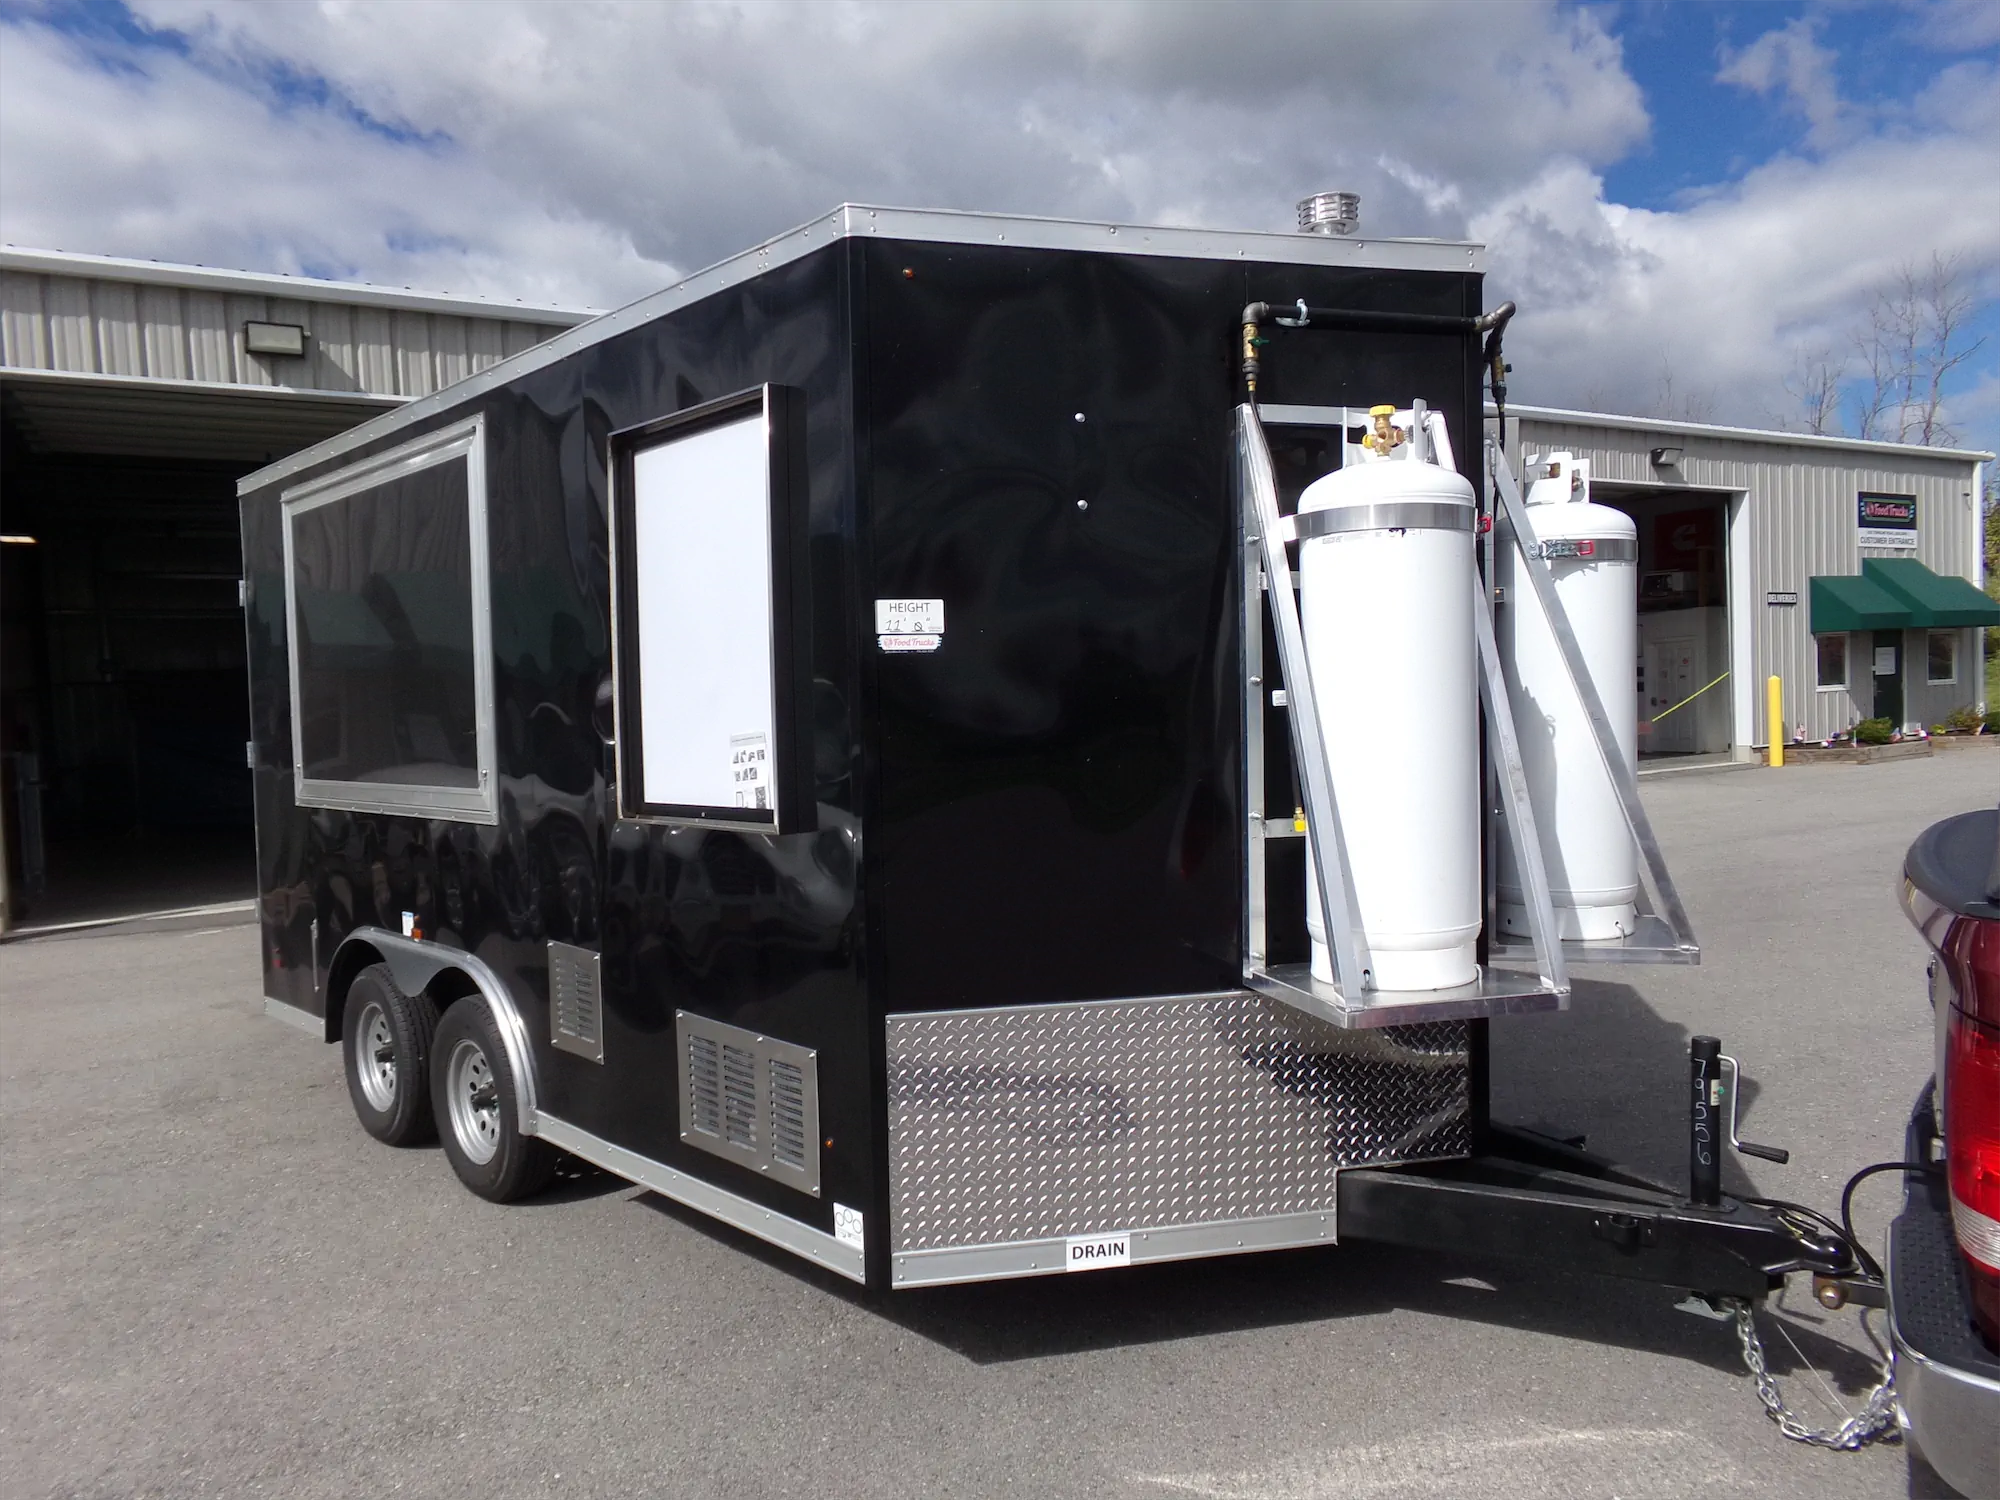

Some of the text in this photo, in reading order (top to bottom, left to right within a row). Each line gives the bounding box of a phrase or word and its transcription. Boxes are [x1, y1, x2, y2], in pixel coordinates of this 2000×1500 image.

[1860, 536, 1915, 545] CUSTOMER ENTRANCE
[889, 602, 931, 613] HEIGHT
[893, 637, 935, 647] Food Trucks
[1694, 1057, 1711, 1165] 79556
[1072, 1242, 1124, 1260] DRAIN
